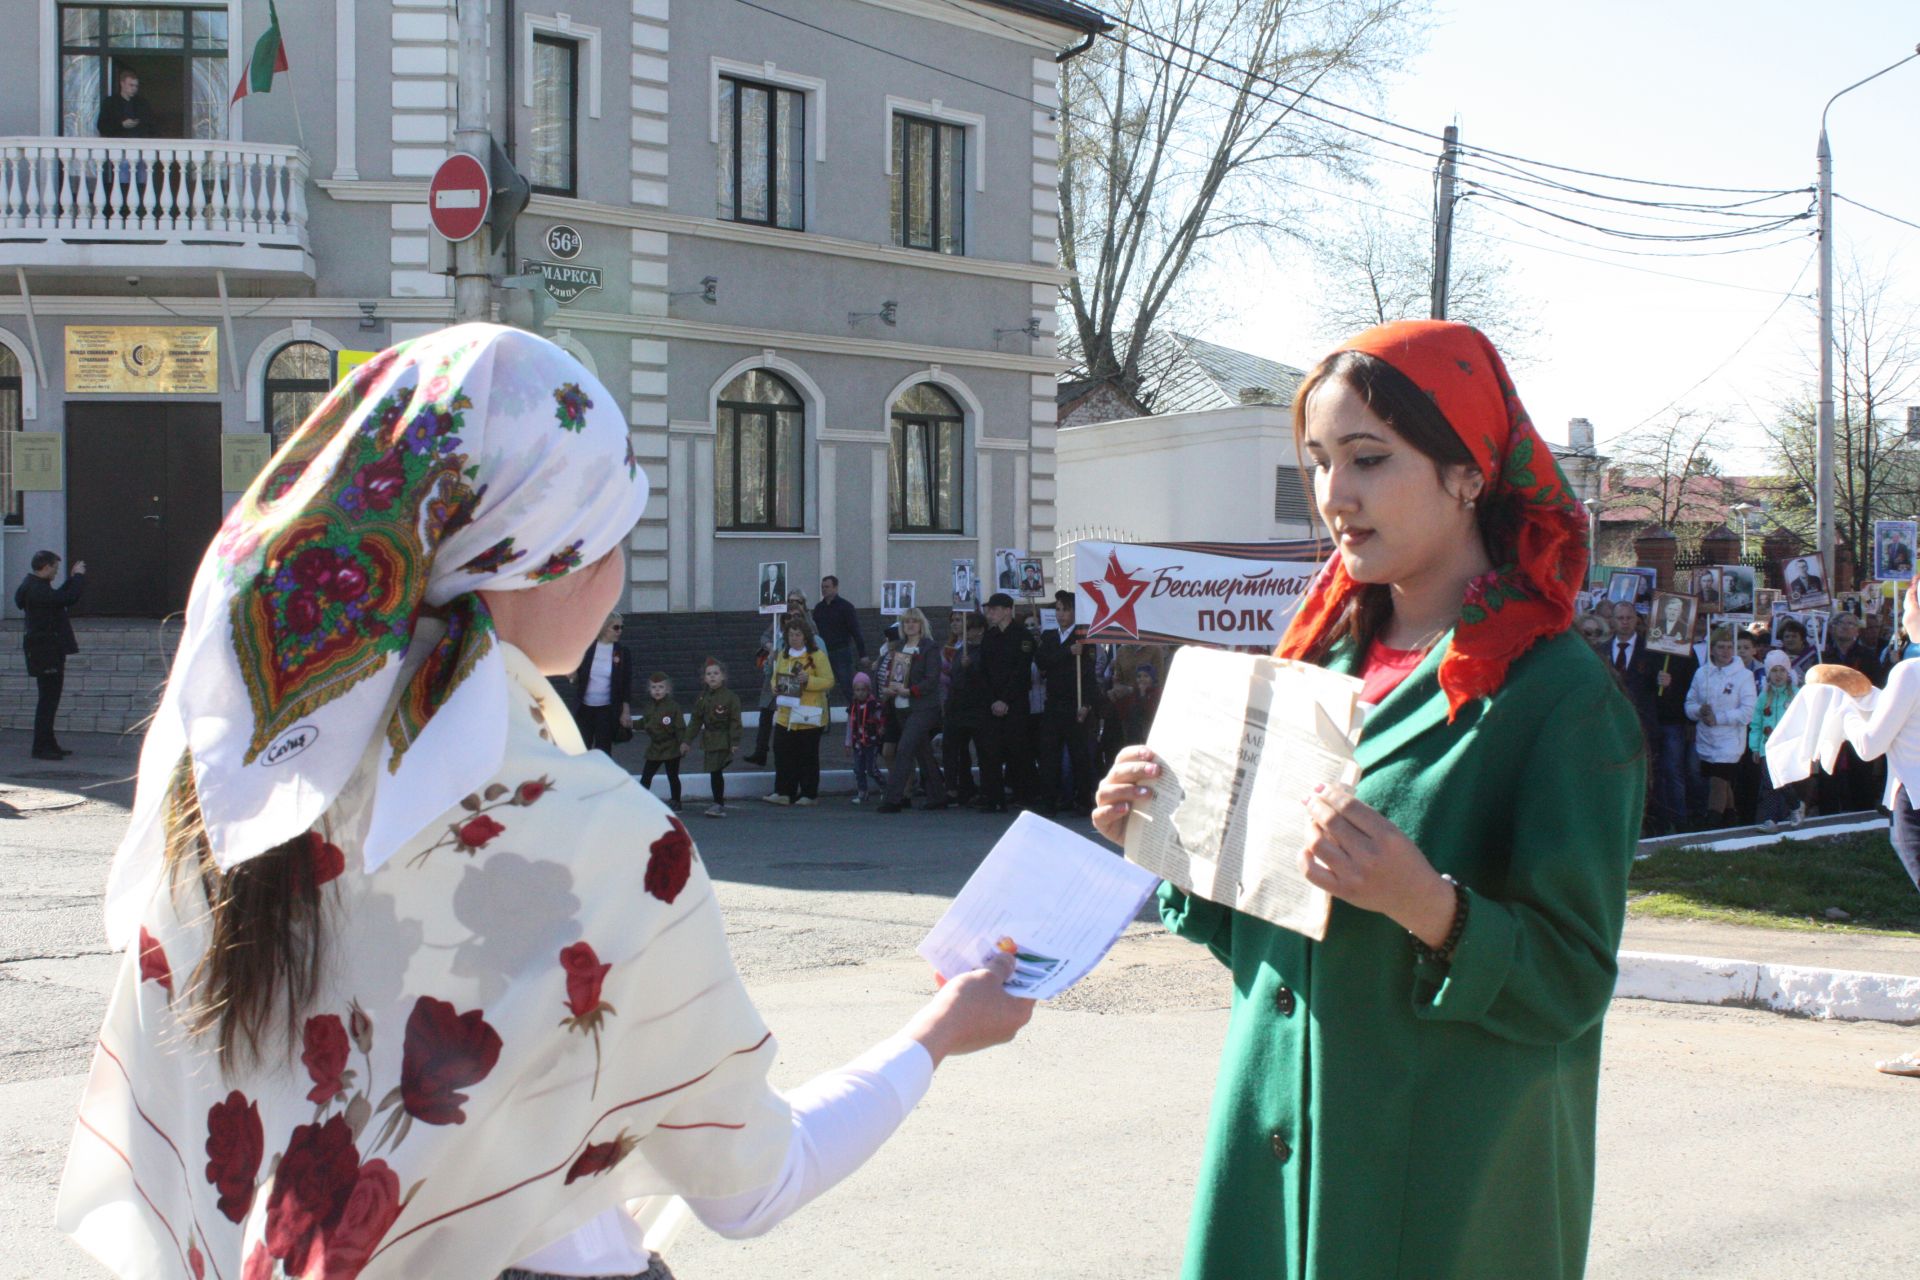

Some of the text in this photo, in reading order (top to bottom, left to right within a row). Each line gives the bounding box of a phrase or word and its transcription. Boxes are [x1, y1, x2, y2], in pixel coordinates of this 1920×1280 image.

[551, 231, 579, 251] 56а
[541, 266, 598, 285] МАРКСА
[1197, 608, 1275, 632] ПОЛК
